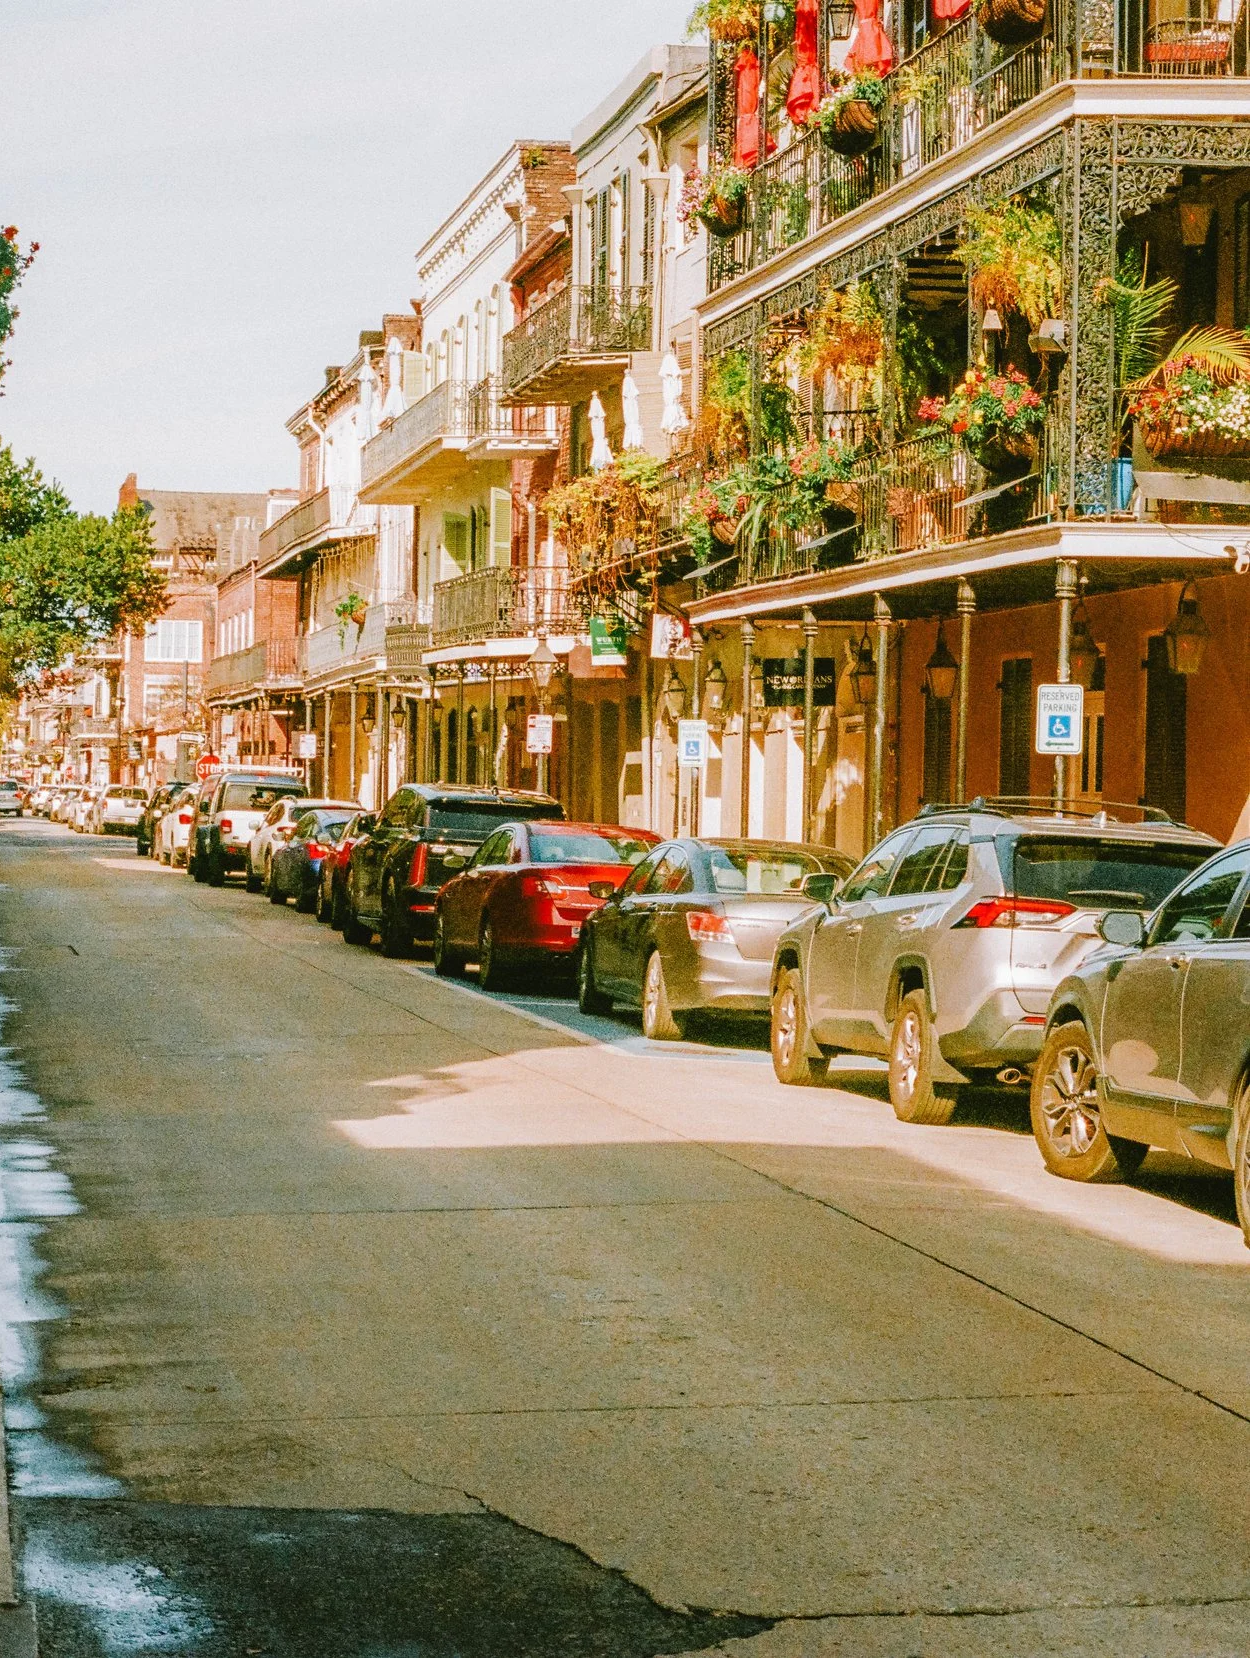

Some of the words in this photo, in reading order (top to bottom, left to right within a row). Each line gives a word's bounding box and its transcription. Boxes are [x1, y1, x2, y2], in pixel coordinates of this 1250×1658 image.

[766, 675, 789, 684] NEW
[789, 675, 833, 684] ORANS
[1041, 691, 1080, 701] RESERVED
[1043, 703, 1077, 712] PARKING
